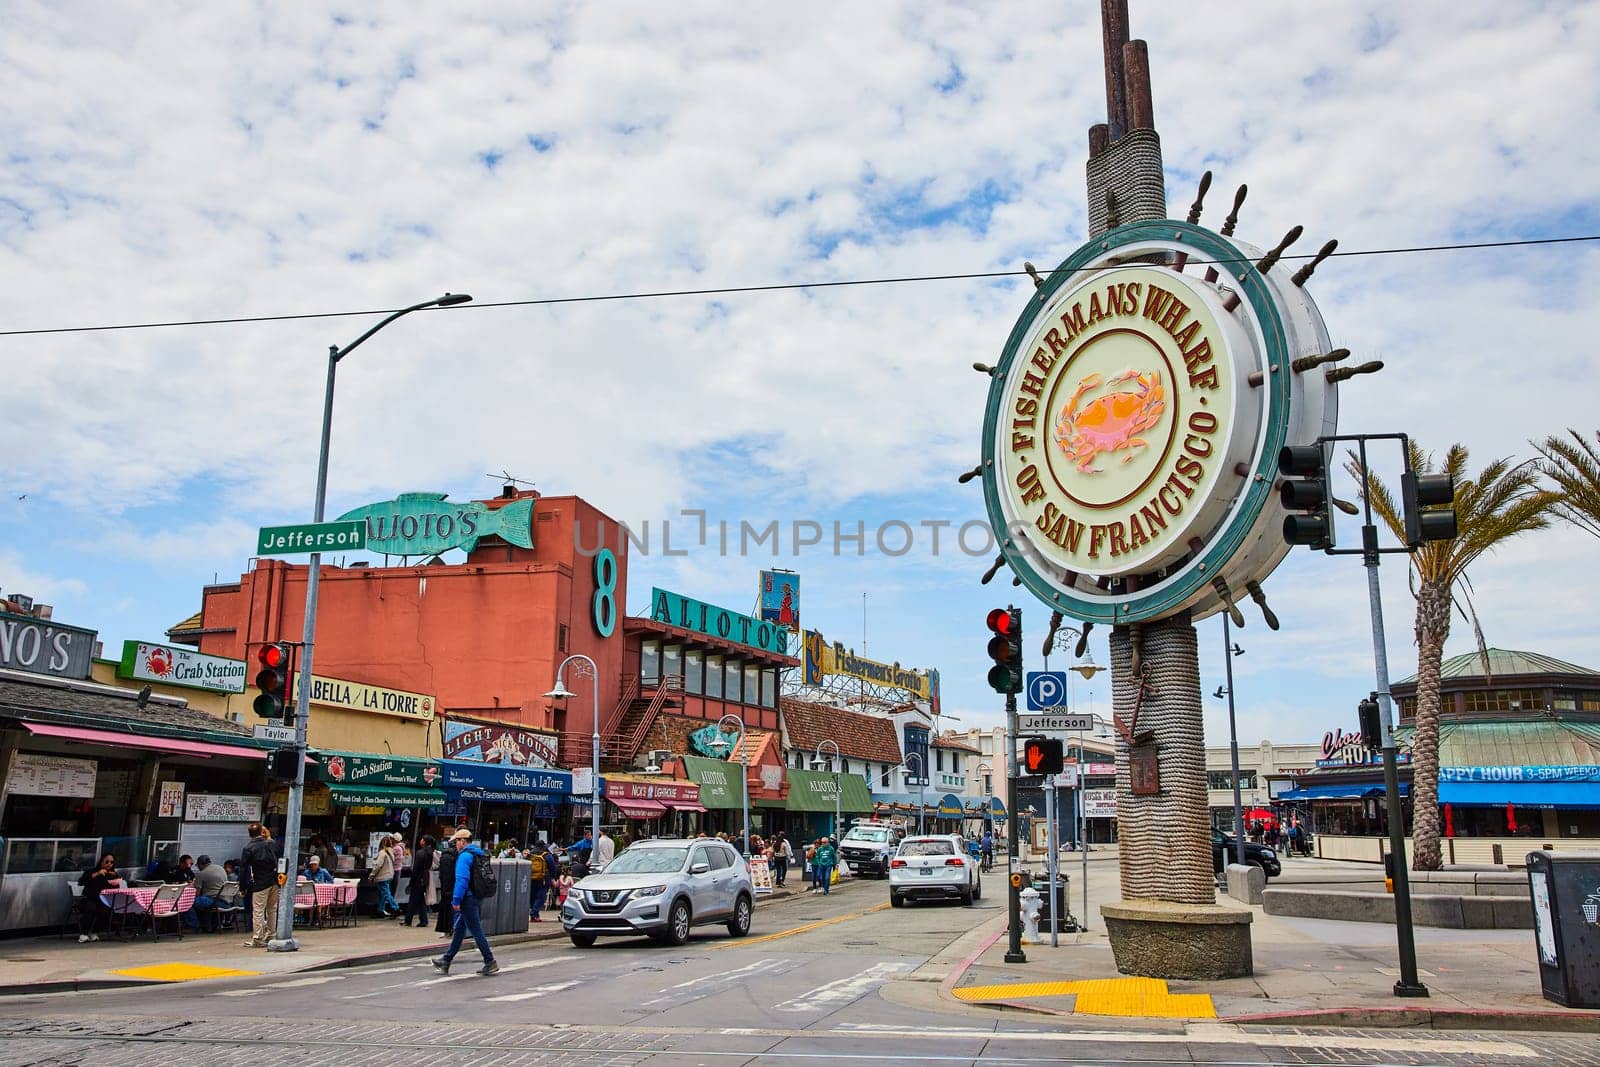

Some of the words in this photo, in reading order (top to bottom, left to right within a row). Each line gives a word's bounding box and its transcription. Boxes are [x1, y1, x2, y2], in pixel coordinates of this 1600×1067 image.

[1012, 282, 1142, 453] FISHERMANS
[1142, 284, 1219, 393] WHARF
[1015, 463, 1047, 506] OF
[1036, 502, 1084, 554] SAN
[1088, 411, 1217, 558] FRANCISCO
[264, 527, 359, 549] Jefferson
[592, 548, 617, 639] 8
[655, 591, 788, 654] ALIOTO'S
[179, 652, 191, 660] The
[174, 662, 204, 680] Crab
[205, 661, 245, 678] Station
[297, 677, 351, 705] BELLA
[363, 688, 378, 709] LA
[381, 691, 418, 714] TORRE
[264, 728, 288, 739] Taylor
[1025, 718, 1086, 728] Jefferson
[446, 728, 492, 756] LIGHT
[518, 732, 557, 765] HOUSE
[351, 765, 369, 780] Crab
[369, 760, 393, 775] Station
[504, 772, 530, 787] Sabella
[540, 775, 564, 789] LaTorre
[1438, 766, 1476, 781] APPY
[1481, 766, 1523, 781] HOUR
[1526, 768, 1563, 780] 3-5PM
[1565, 766, 1600, 776] WEEKD
